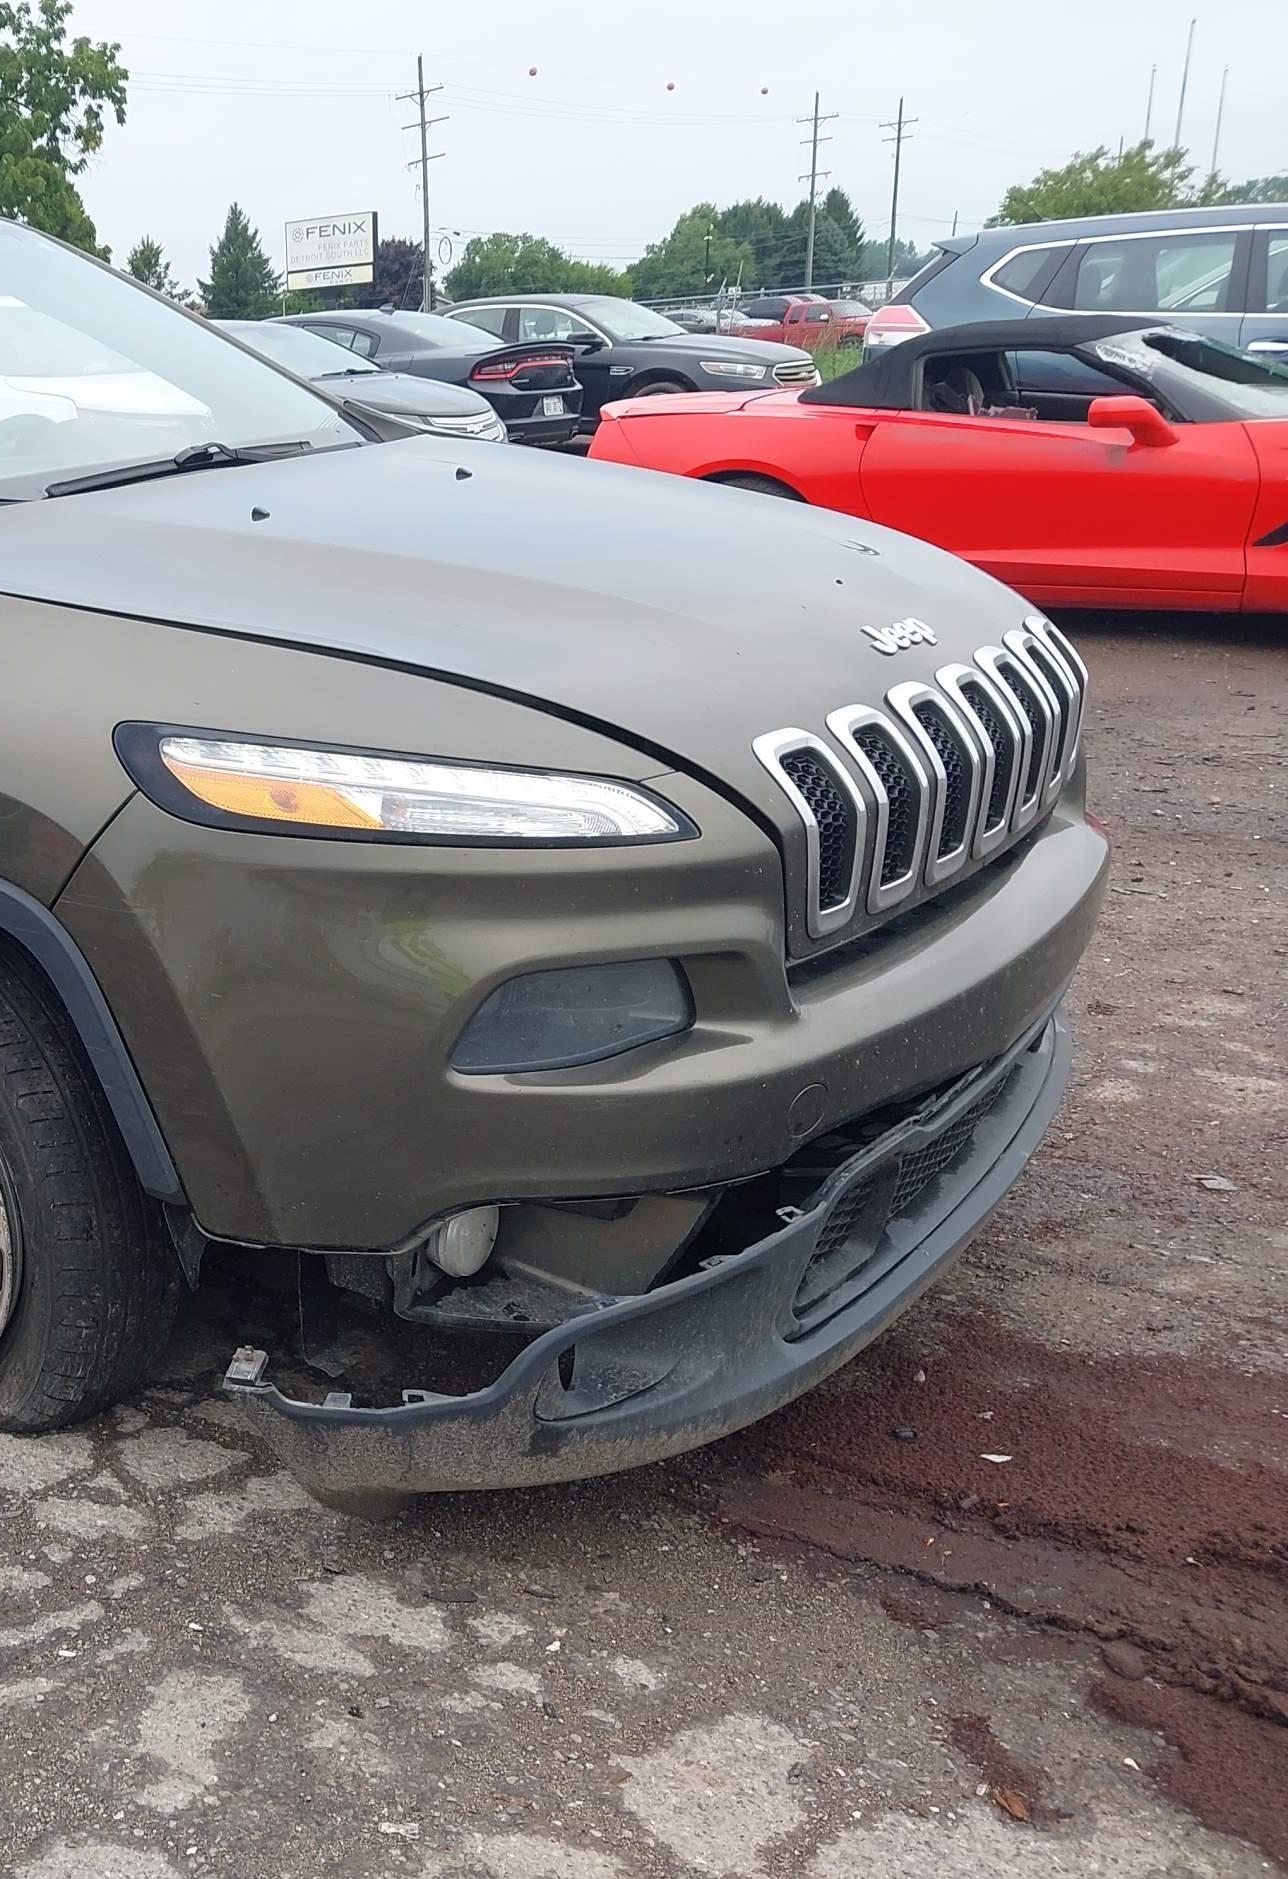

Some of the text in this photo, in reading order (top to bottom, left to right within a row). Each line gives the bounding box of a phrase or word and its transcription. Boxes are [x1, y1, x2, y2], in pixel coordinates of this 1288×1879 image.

[305, 221, 366, 240] FENIX
[314, 269, 353, 281] FENIX
[859, 617, 938, 656] Jeep
